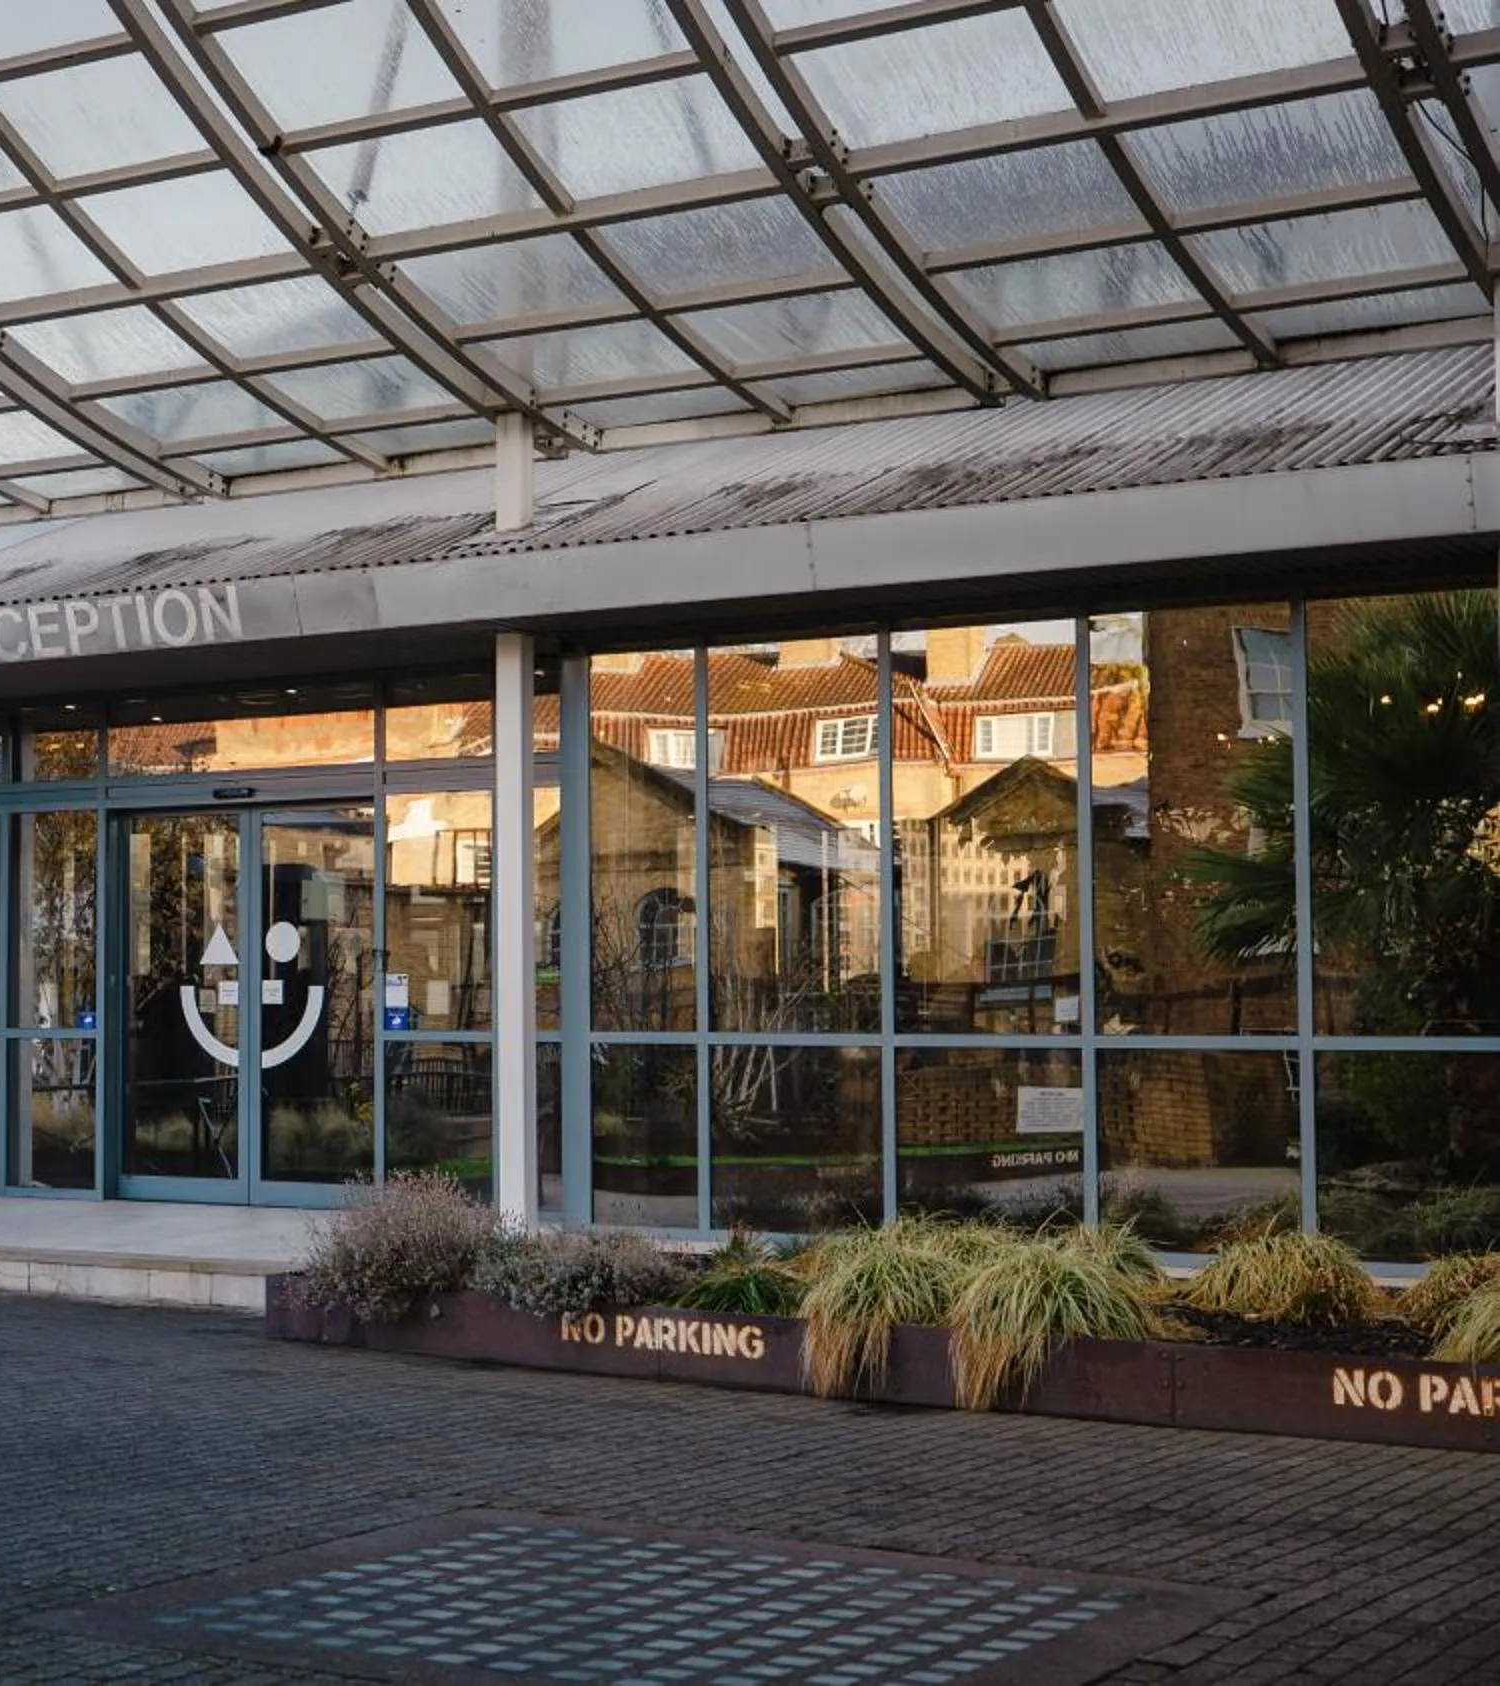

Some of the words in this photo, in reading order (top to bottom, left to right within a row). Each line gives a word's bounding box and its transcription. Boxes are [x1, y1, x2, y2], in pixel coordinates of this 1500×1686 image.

[561, 1311, 604, 1344] NO
[615, 1315, 764, 1359] PARKING
[1332, 1367, 1403, 1411] NO
